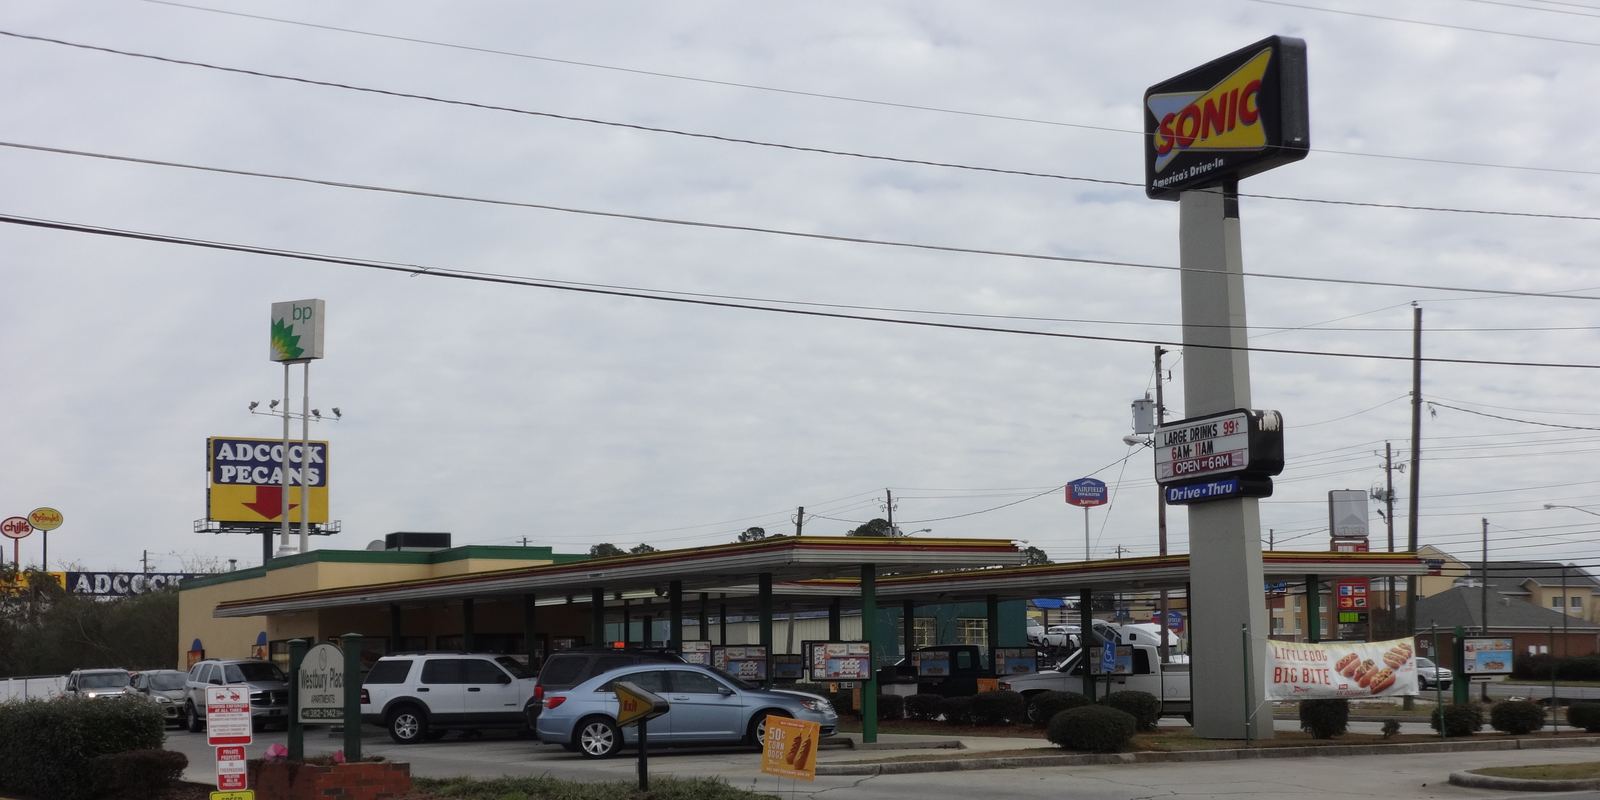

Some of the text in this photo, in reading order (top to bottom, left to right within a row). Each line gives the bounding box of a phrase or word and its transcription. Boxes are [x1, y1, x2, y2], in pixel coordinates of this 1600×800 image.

[1158, 79, 1261, 157] SONIC
[1152, 168, 1189, 189] America's
[292, 304, 312, 324] bp
[1164, 428, 1187, 446] LARGE
[1189, 423, 1217, 441] DRINKS
[216, 443, 323, 464] ADCOCK
[220, 466, 319, 486] PECANS
[1175, 459, 1200, 474] OPEN
[73, 574, 184, 594] ADCOCK
[300, 669, 328, 692] Westbury
[1273, 666, 1330, 685] BIG BITE
[767, 749, 784, 760] DOGS
[768, 740, 785, 750] CORN
